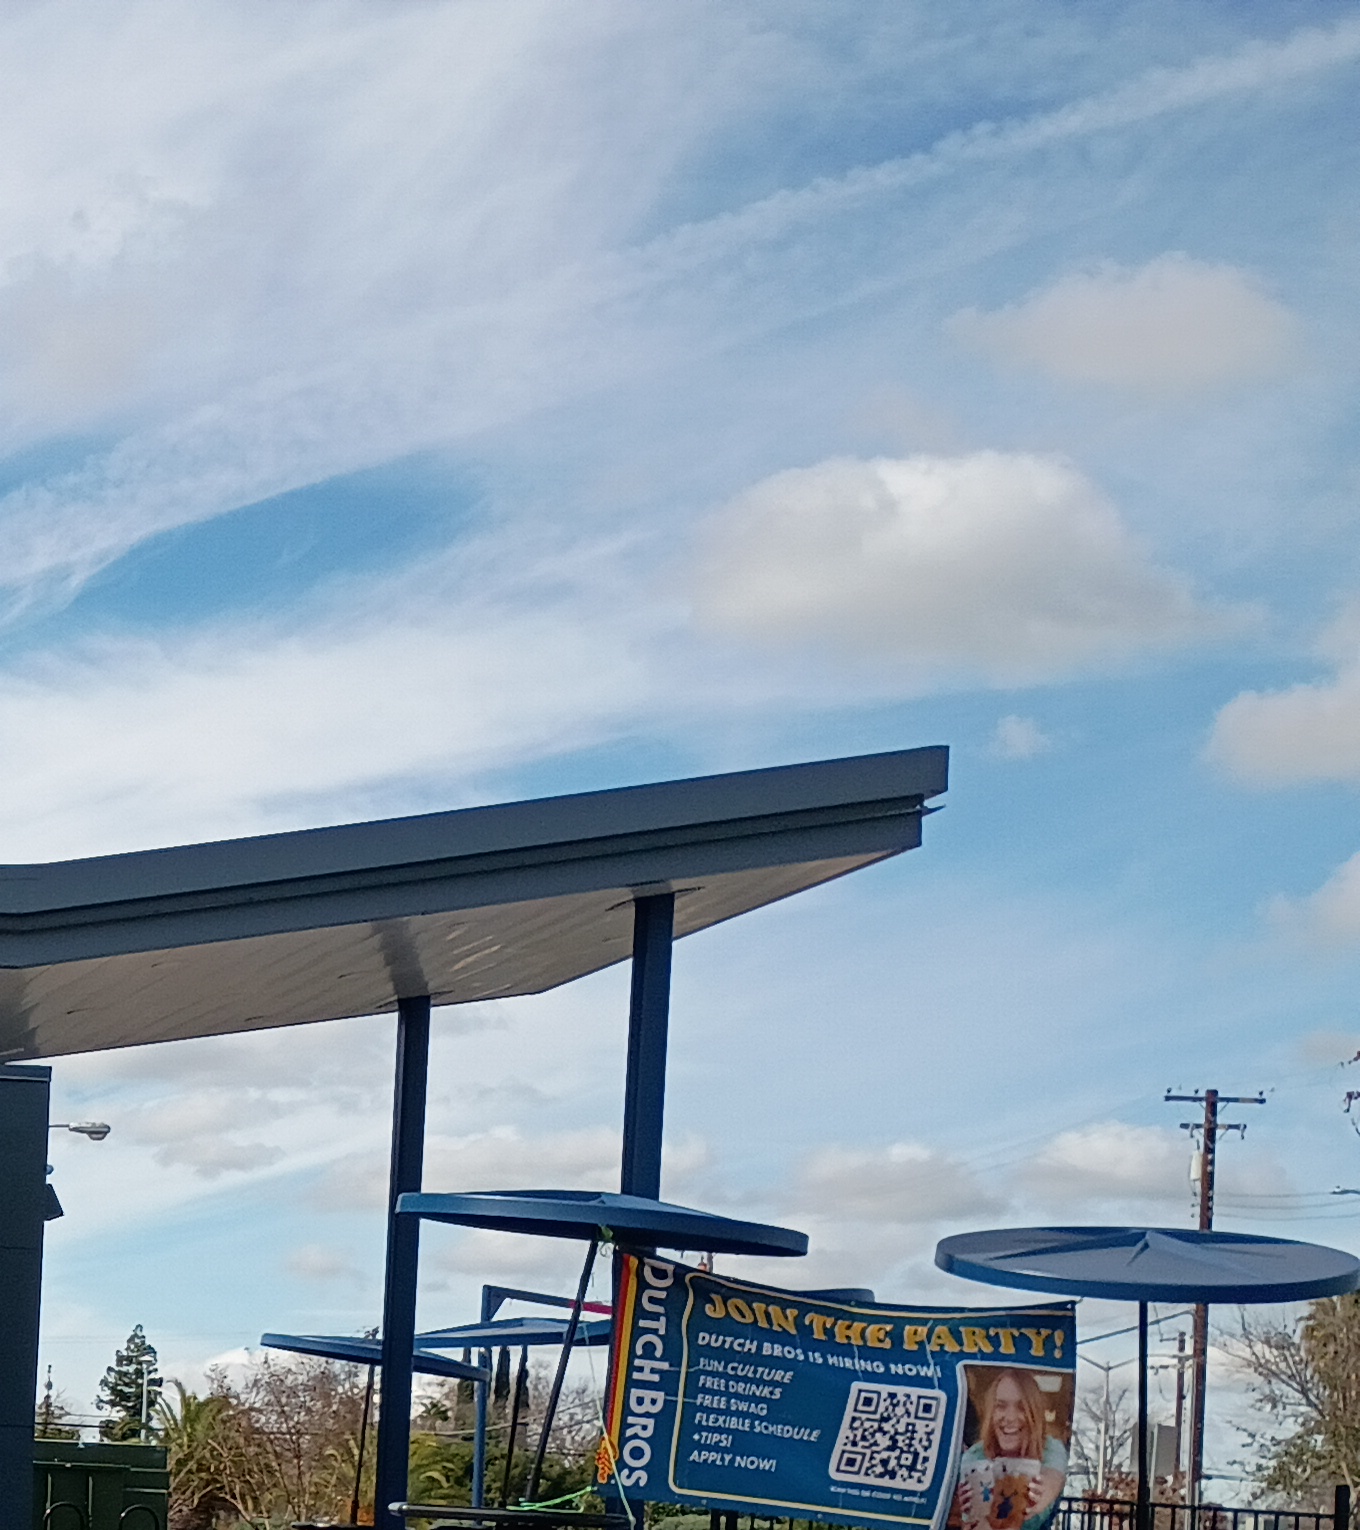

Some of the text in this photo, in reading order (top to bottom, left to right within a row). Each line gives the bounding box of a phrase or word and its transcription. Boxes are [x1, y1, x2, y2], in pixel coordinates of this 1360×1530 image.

[704, 1293, 1065, 1359] JOIN THE PARTY!
[697, 1331, 942, 1379] DUTCH BROS IS HIRING NOW!
[620, 1257, 675, 1488] DUTCH BROS
[699, 1357, 794, 1384] FUN CULTURE
[698, 1375, 782, 1399] FREE DRINKS
[696, 1393, 768, 1416] FREE SWAG
[694, 1412, 821, 1442] FLEXIBLE SCHEDULE
[689, 1449, 777, 1472] APPLY NOW!
